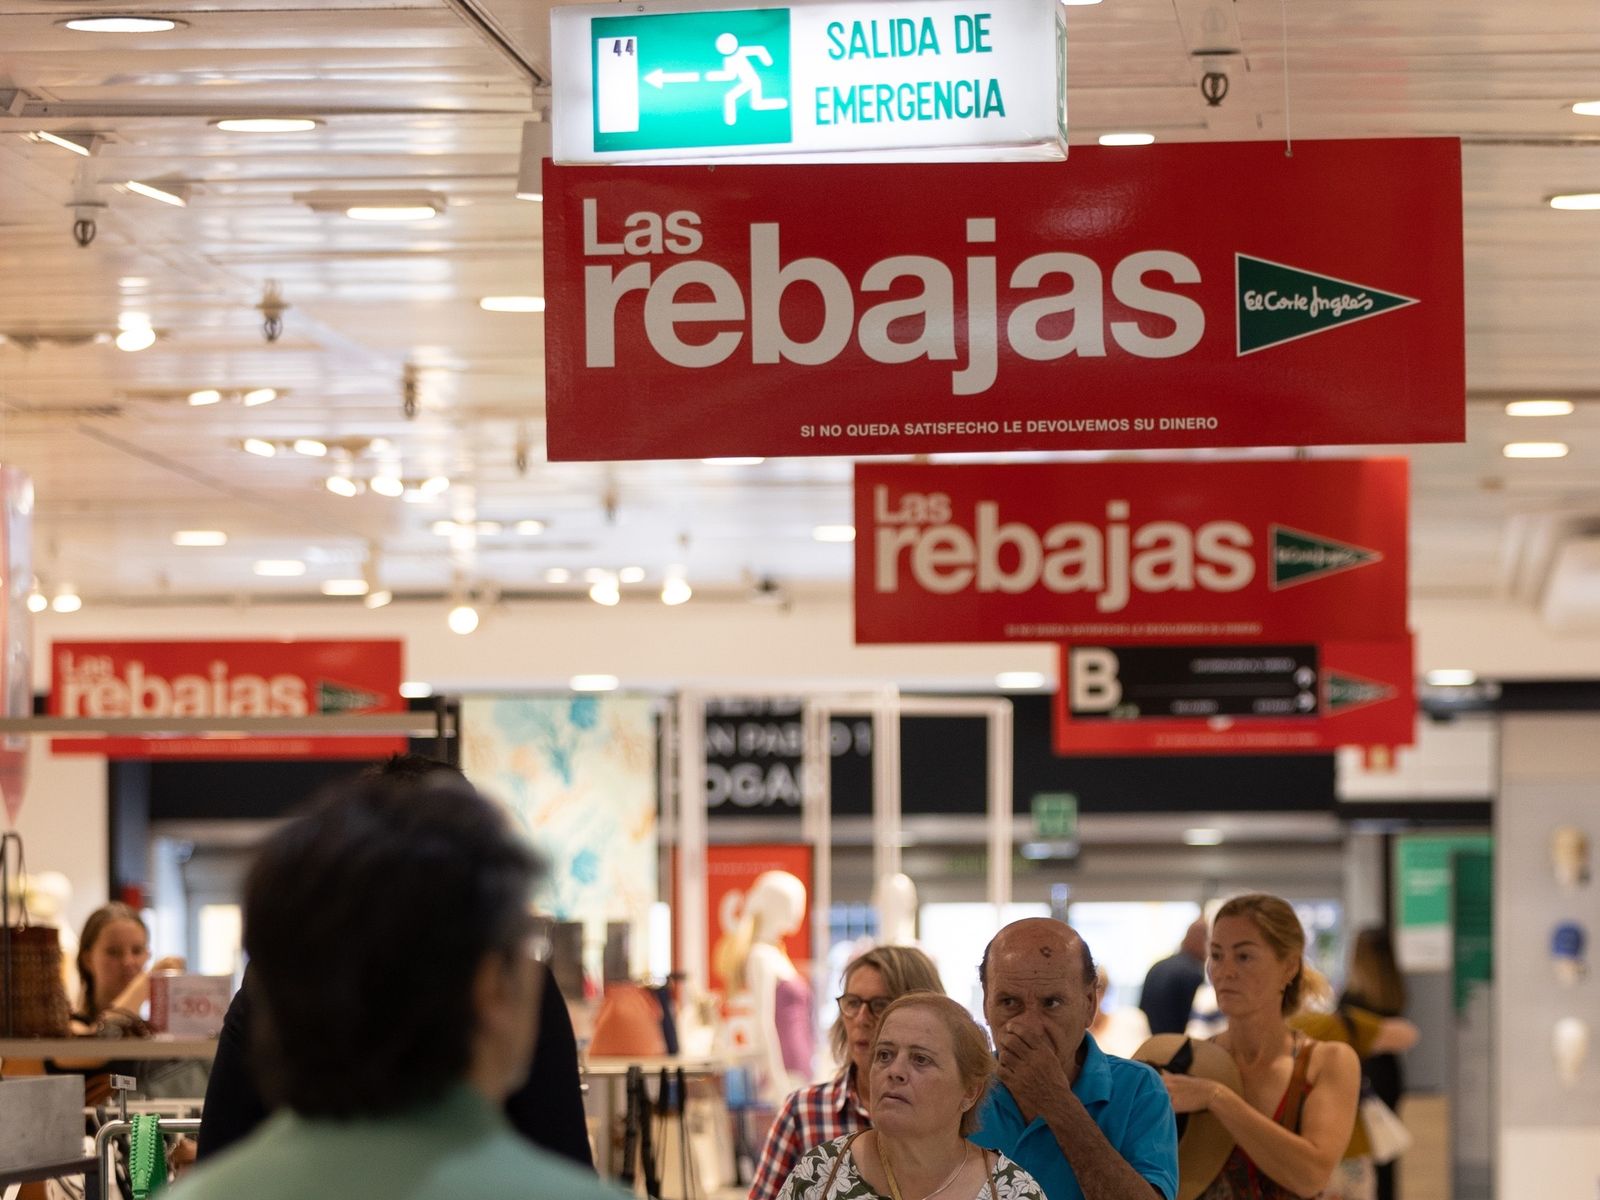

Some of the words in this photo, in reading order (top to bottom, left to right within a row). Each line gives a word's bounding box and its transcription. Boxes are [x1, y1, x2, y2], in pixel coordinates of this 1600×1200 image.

[826, 16, 941, 61] SALIDA
[954, 13, 993, 54] DE
[815, 78, 1006, 126] EMERGENCIA
[583, 198, 703, 256] Las
[584, 217, 1206, 396] rebajas
[1243, 289, 1264, 312] El
[800, 424, 815, 438] SI
[819, 424, 842, 437] NO
[846, 423, 900, 437] QUEDA
[904, 421, 999, 435] SATISFECHO
[1003, 420, 1023, 433] LE
[1026, 418, 1130, 433] DEVOLVEMOS
[1133, 418, 1155, 431] SU
[1159, 416, 1219, 431] DINERO
[873, 483, 953, 525] Las
[873, 500, 1257, 614] rebajas
[1068, 646, 1123, 714] B
